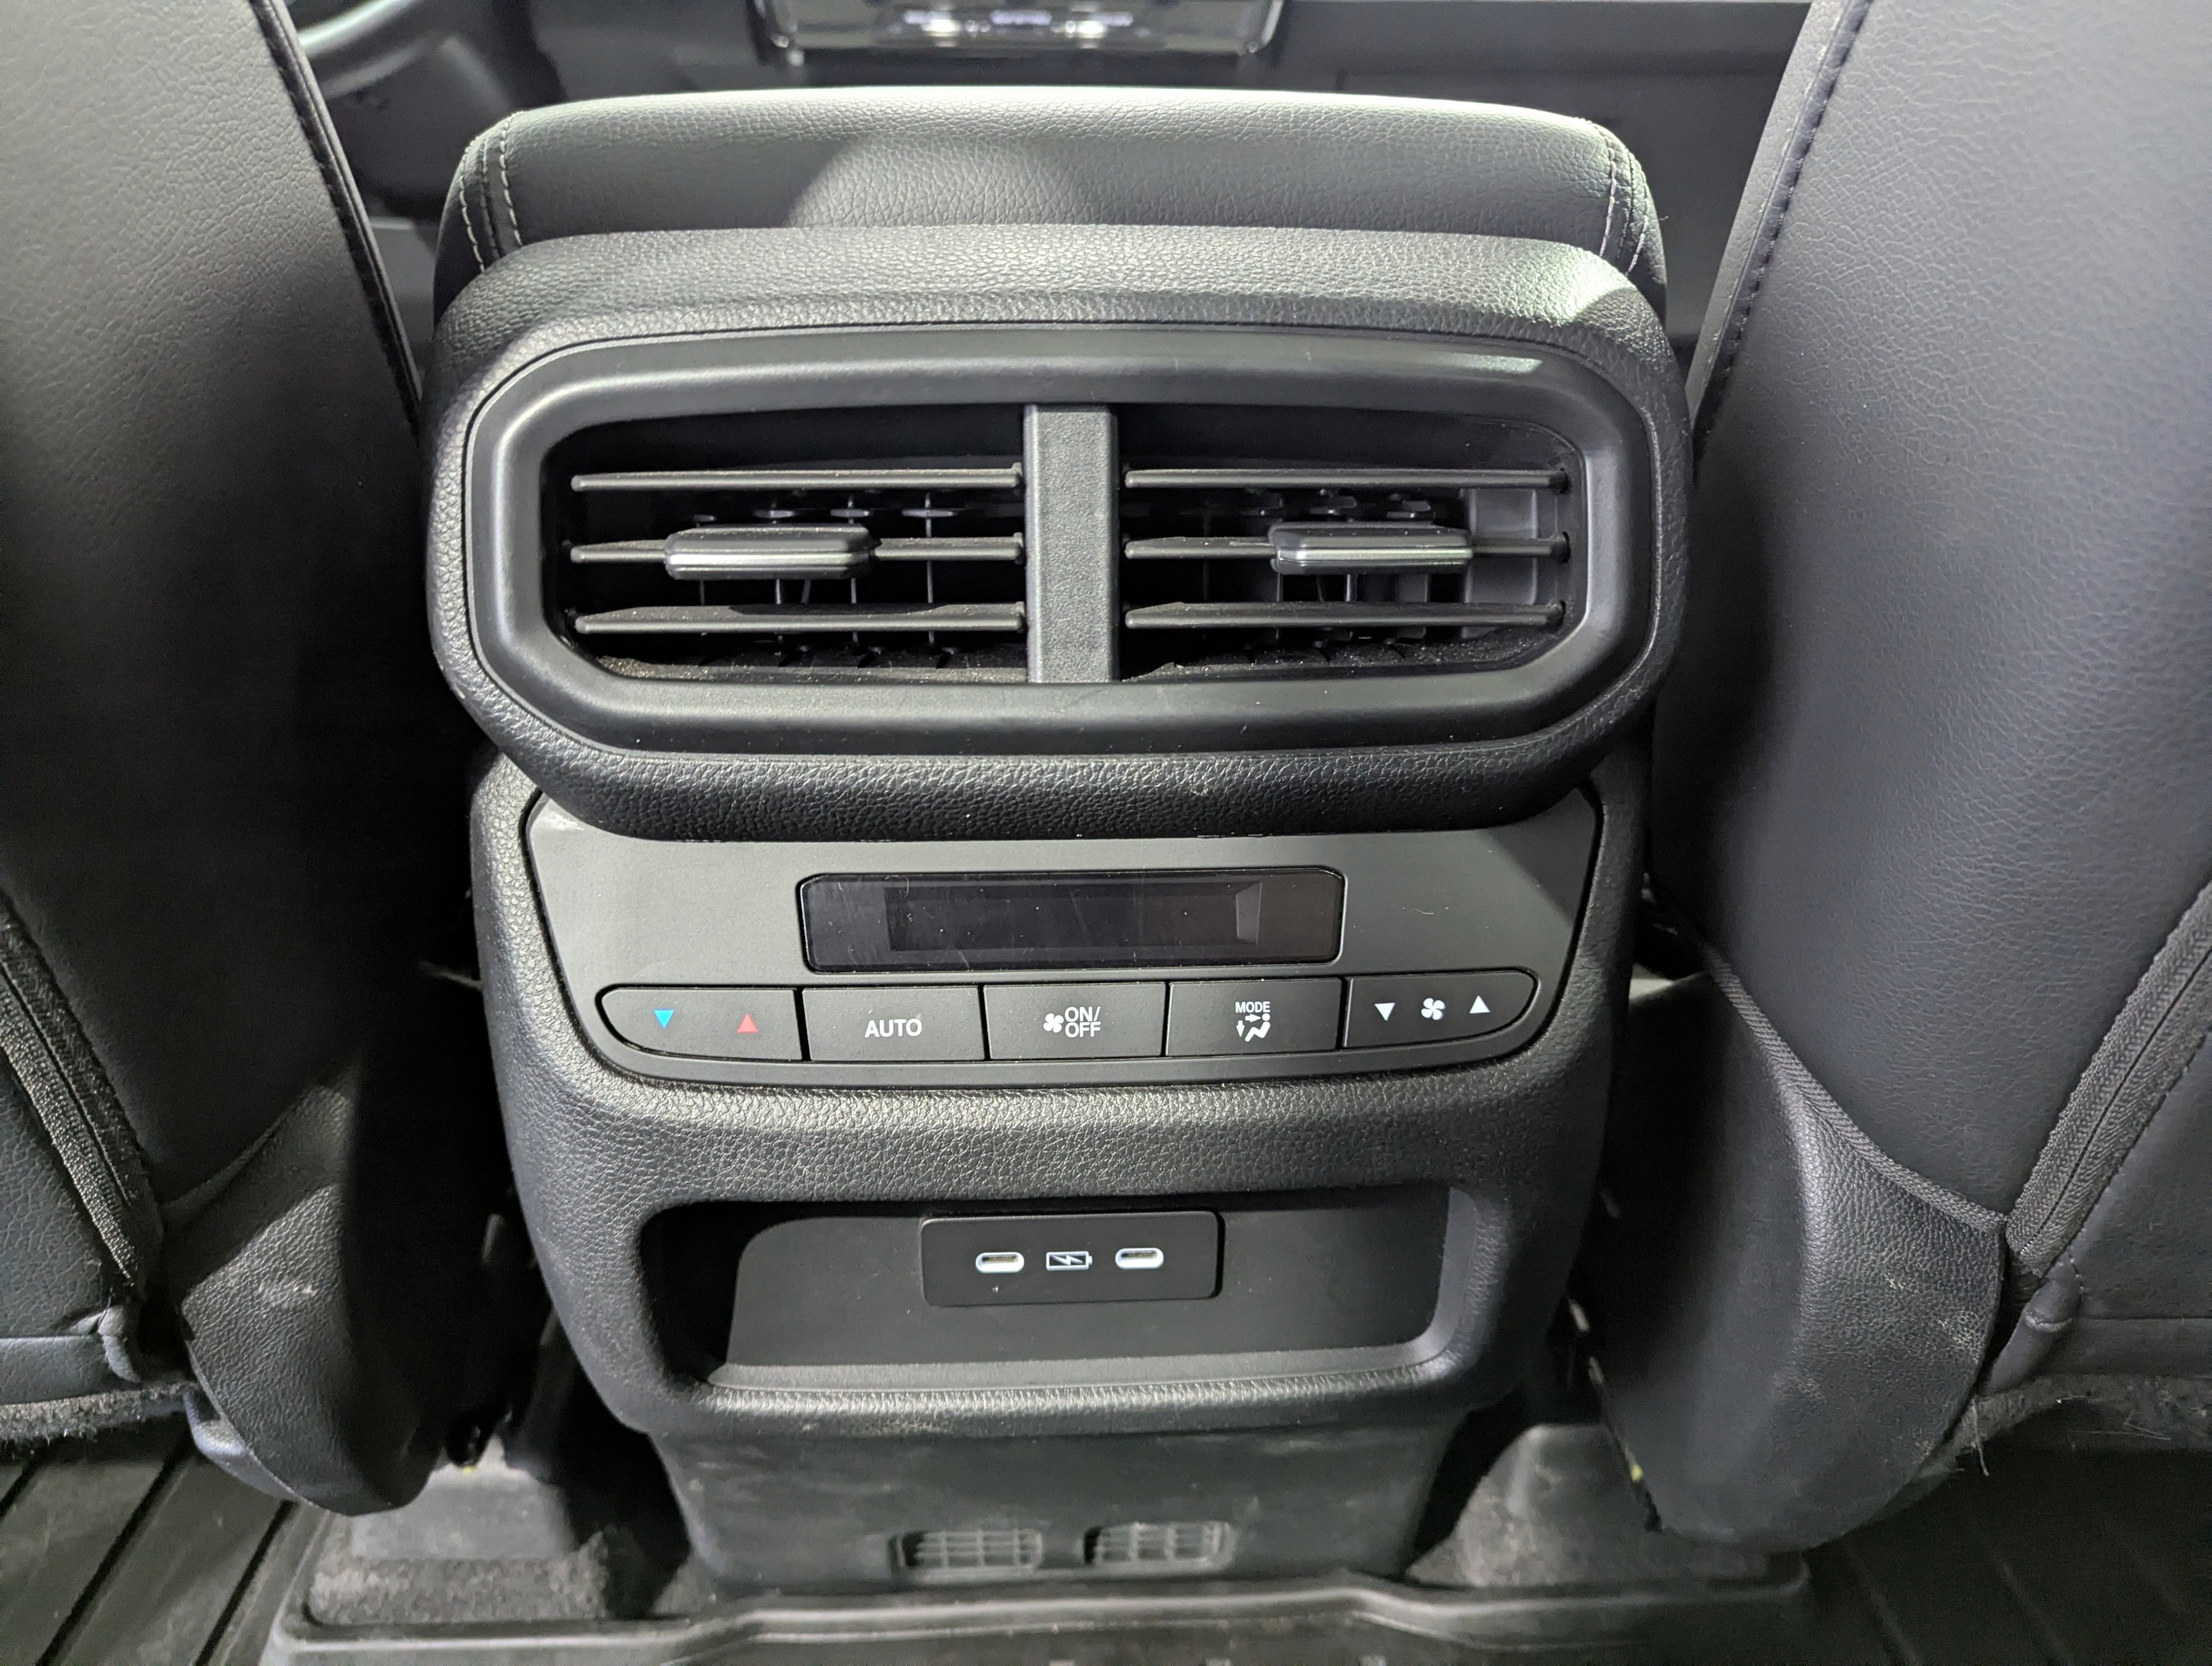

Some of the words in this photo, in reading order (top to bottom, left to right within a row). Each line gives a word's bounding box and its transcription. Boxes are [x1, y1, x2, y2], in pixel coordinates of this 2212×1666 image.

[1064, 1006, 1101, 1022] ON/
[1235, 1001, 1271, 1013] MODE
[864, 1018, 923, 1038] AUTO
[1065, 1021, 1102, 1038] OFF
